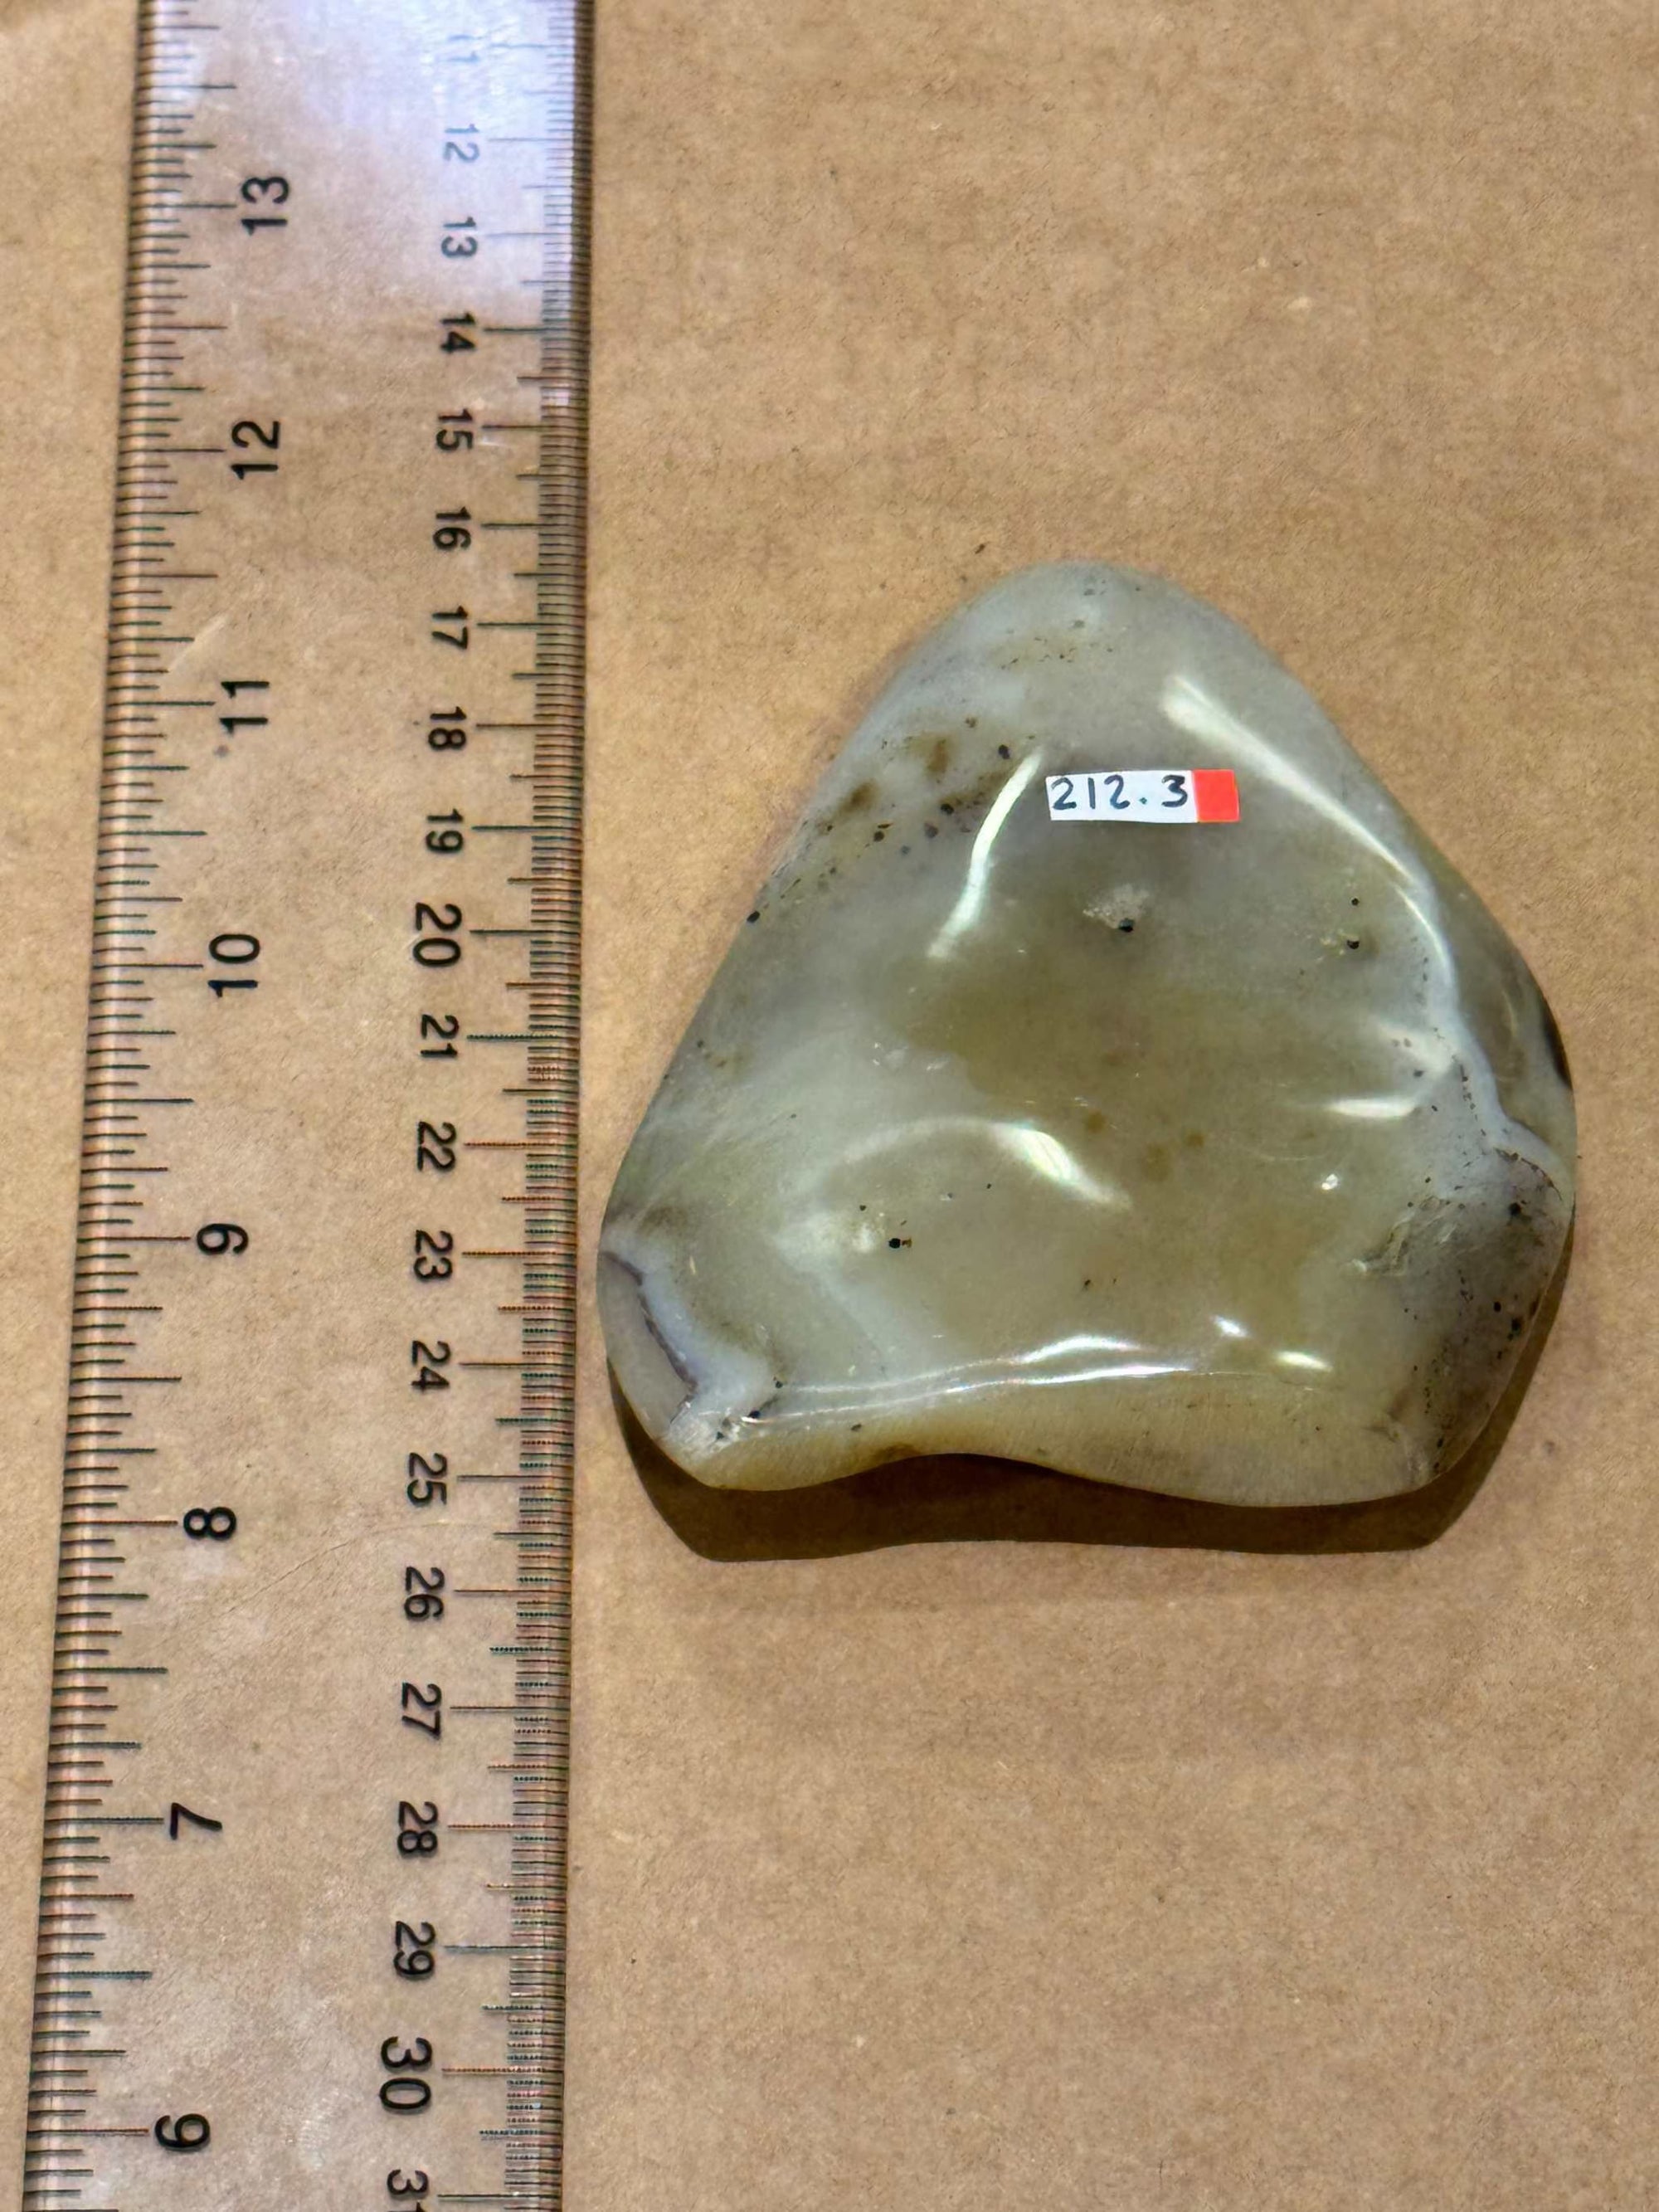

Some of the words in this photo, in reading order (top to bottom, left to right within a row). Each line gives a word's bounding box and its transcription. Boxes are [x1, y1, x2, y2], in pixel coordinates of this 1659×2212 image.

[442, 123, 480, 163] 12
[241, 176, 289, 234] 13
[440, 217, 478, 258] 13
[440, 313, 475, 353] 14
[230, 421, 280, 480] 12
[435, 409, 474, 451] 15
[433, 506, 471, 550] 16
[431, 606, 469, 650] 17
[219, 680, 270, 734] 11
[427, 706, 467, 751] 18
[1050, 774, 1189, 810] 212.3
[426, 808, 464, 854] 19
[413, 902, 463, 967] 20
[207, 933, 260, 998] 10
[421, 1014, 460, 1059] 21
[416, 1121, 456, 1172] 22
[196, 1223, 249, 1255] 9
[413, 1230, 454, 1282] 23
[411, 1340, 451, 1392] 24
[406, 1452, 448, 1506] 25
[182, 1507, 237, 1542] 8
[404, 1566, 445, 1620] 26
[401, 1683, 442, 1740] 27
[169, 1802, 223, 1840] 7
[397, 1801, 438, 1856] 28
[393, 1921, 435, 1980] 29
[379, 2036, 433, 2111] 30
[154, 2113, 211, 2153] 6
